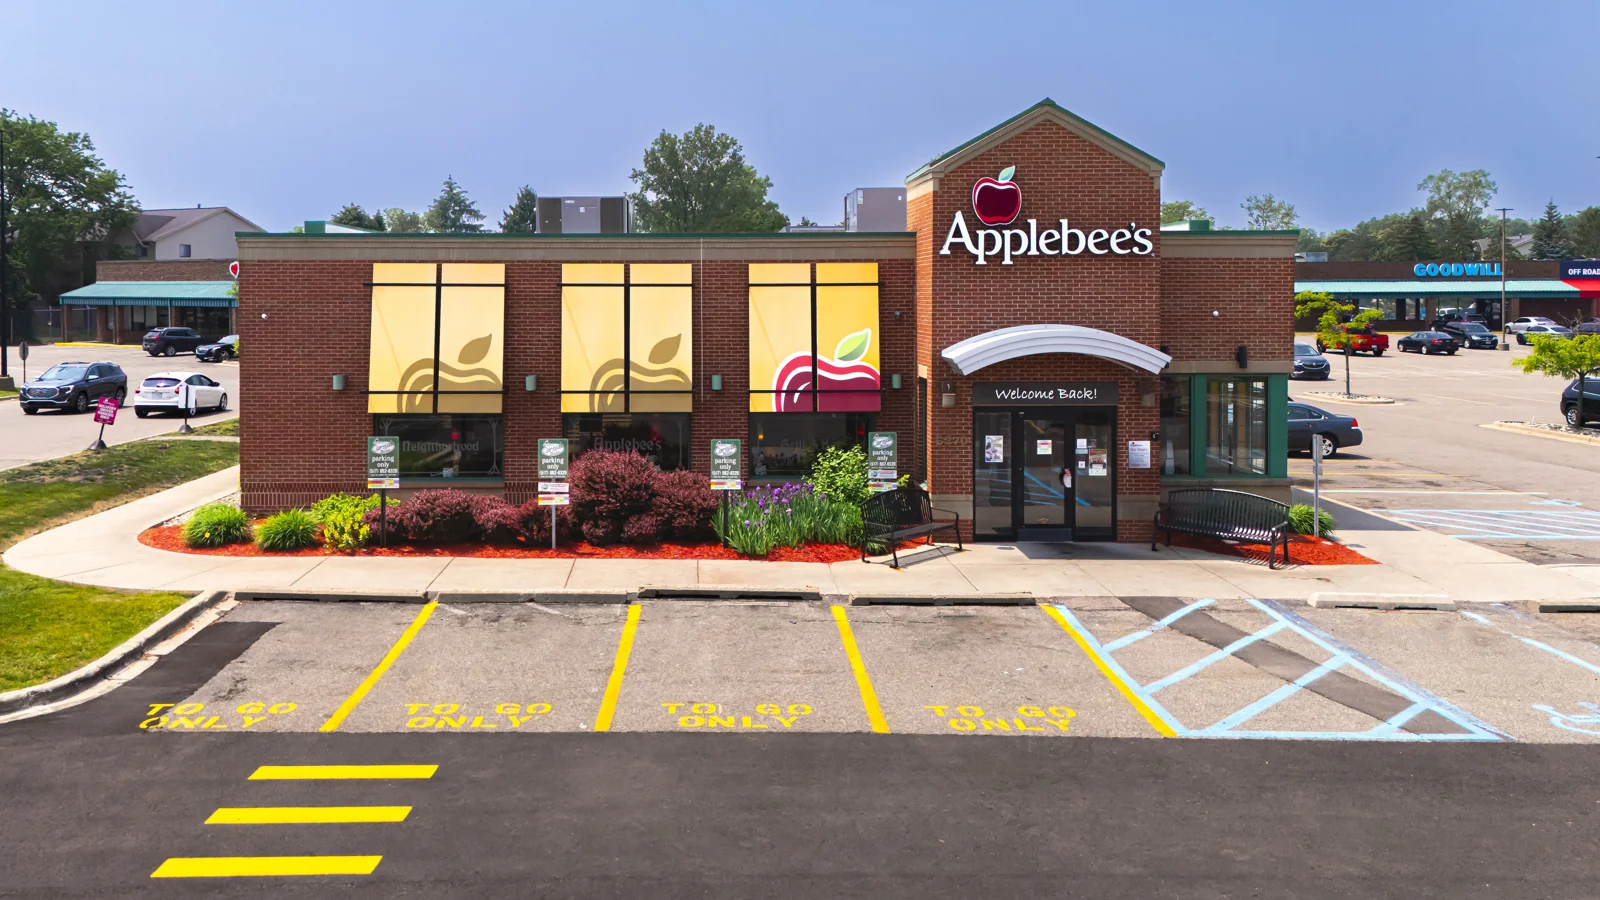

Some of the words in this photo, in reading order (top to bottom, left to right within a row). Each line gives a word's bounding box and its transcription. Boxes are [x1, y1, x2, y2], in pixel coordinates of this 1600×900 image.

[939, 210, 1154, 265] Applebee's
[1413, 263, 1503, 277] GOODWILL
[995, 387, 1054, 399] Welcome
[1057, 387, 1097, 399] Back!
[371, 455, 395, 463] parking
[146, 703, 205, 716] TO
[235, 702, 297, 715] GO
[404, 703, 460, 715] TO
[494, 703, 552, 715] GO
[661, 703, 717, 715] TO
[755, 703, 813, 715] GO
[924, 705, 985, 717] TO
[1017, 705, 1077, 718] GO
[139, 715, 267, 729] ONLY
[406, 715, 532, 729] ONLY
[678, 715, 798, 729] ONLY
[949, 718, 1070, 731] ONLY
